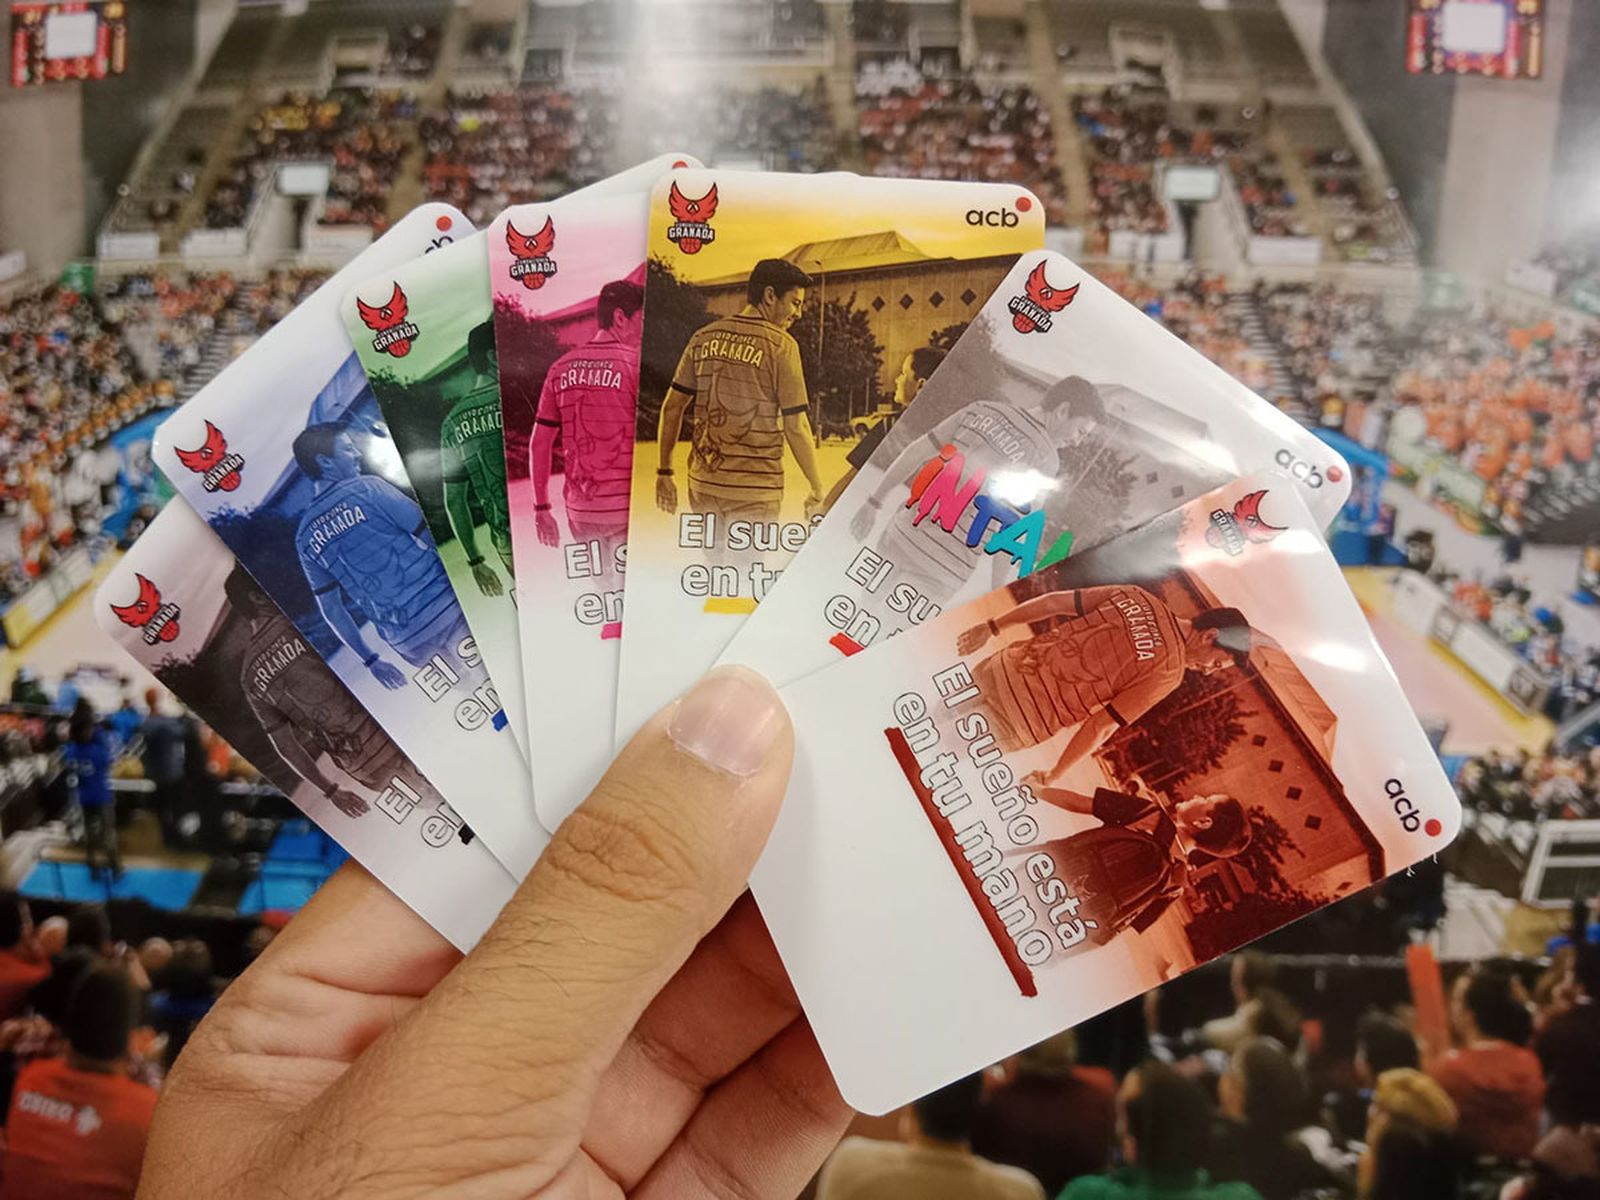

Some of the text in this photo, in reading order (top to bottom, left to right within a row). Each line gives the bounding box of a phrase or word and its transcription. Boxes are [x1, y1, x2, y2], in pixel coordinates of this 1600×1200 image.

[669, 227, 714, 240] GRANADA
[965, 206, 1020, 229] acb
[510, 262, 556, 276] GRANADA
[1010, 298, 1052, 331] GRANADA
[375, 323, 419, 351] GRANADA
[700, 339, 763, 367] GRANADA
[560, 368, 621, 389] GRANADA
[455, 411, 503, 444] GRANAD
[204, 454, 243, 491] GRANADA
[1275, 448, 1323, 489] acb
[309, 505, 367, 553] GRANADA
[679, 512, 716, 548] El
[564, 540, 602, 579] El
[680, 563, 739, 598] en
[845, 546, 942, 625] El su
[144, 604, 181, 644] GRANADA
[824, 594, 881, 648] en
[1116, 598, 1155, 661] GRANADA
[254, 638, 306, 692] GRANADA
[413, 654, 460, 702] El
[375, 776, 422, 824] El
[932, 661, 1098, 950] El sueño está
[1384, 777, 1421, 834] acb
[892, 691, 1054, 968] en tu mano
